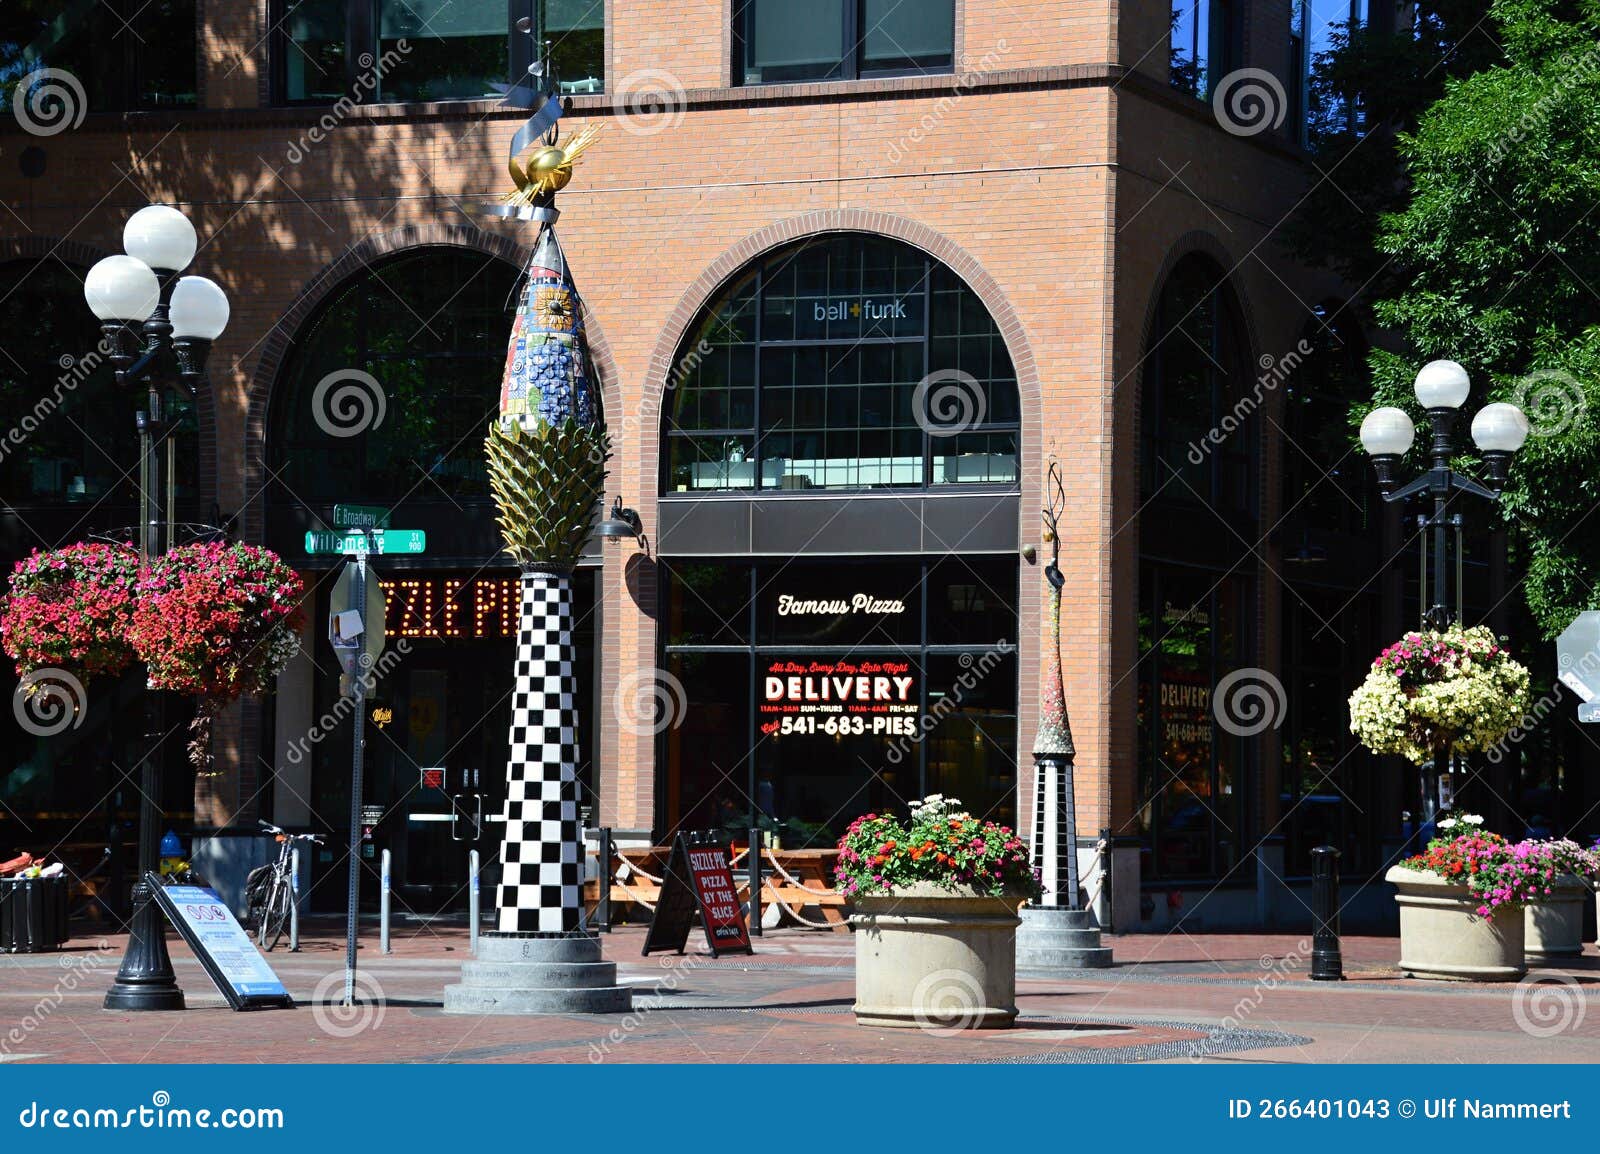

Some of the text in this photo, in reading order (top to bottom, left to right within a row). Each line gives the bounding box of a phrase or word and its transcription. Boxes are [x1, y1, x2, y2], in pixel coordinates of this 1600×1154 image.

[343, 508, 376, 526] Broadway
[310, 534, 385, 550] Willamette
[408, 542, 422, 550] 900
[378, 579, 465, 637] ZZLE
[778, 594, 905, 615] Famous Pizza
[809, 662, 835, 674] Every
[860, 663, 881, 673] Late
[882, 663, 908, 674] Night
[765, 677, 913, 700] DELIVERY
[1161, 683, 1211, 709] DELIVERY
[781, 716, 916, 735] 541-683-PIES
[690, 852, 727, 871] SIZZLE PIE
[702, 876, 727, 888] PIZZA
[704, 891, 734, 904] BY THE
[711, 906, 734, 918] SLICE
